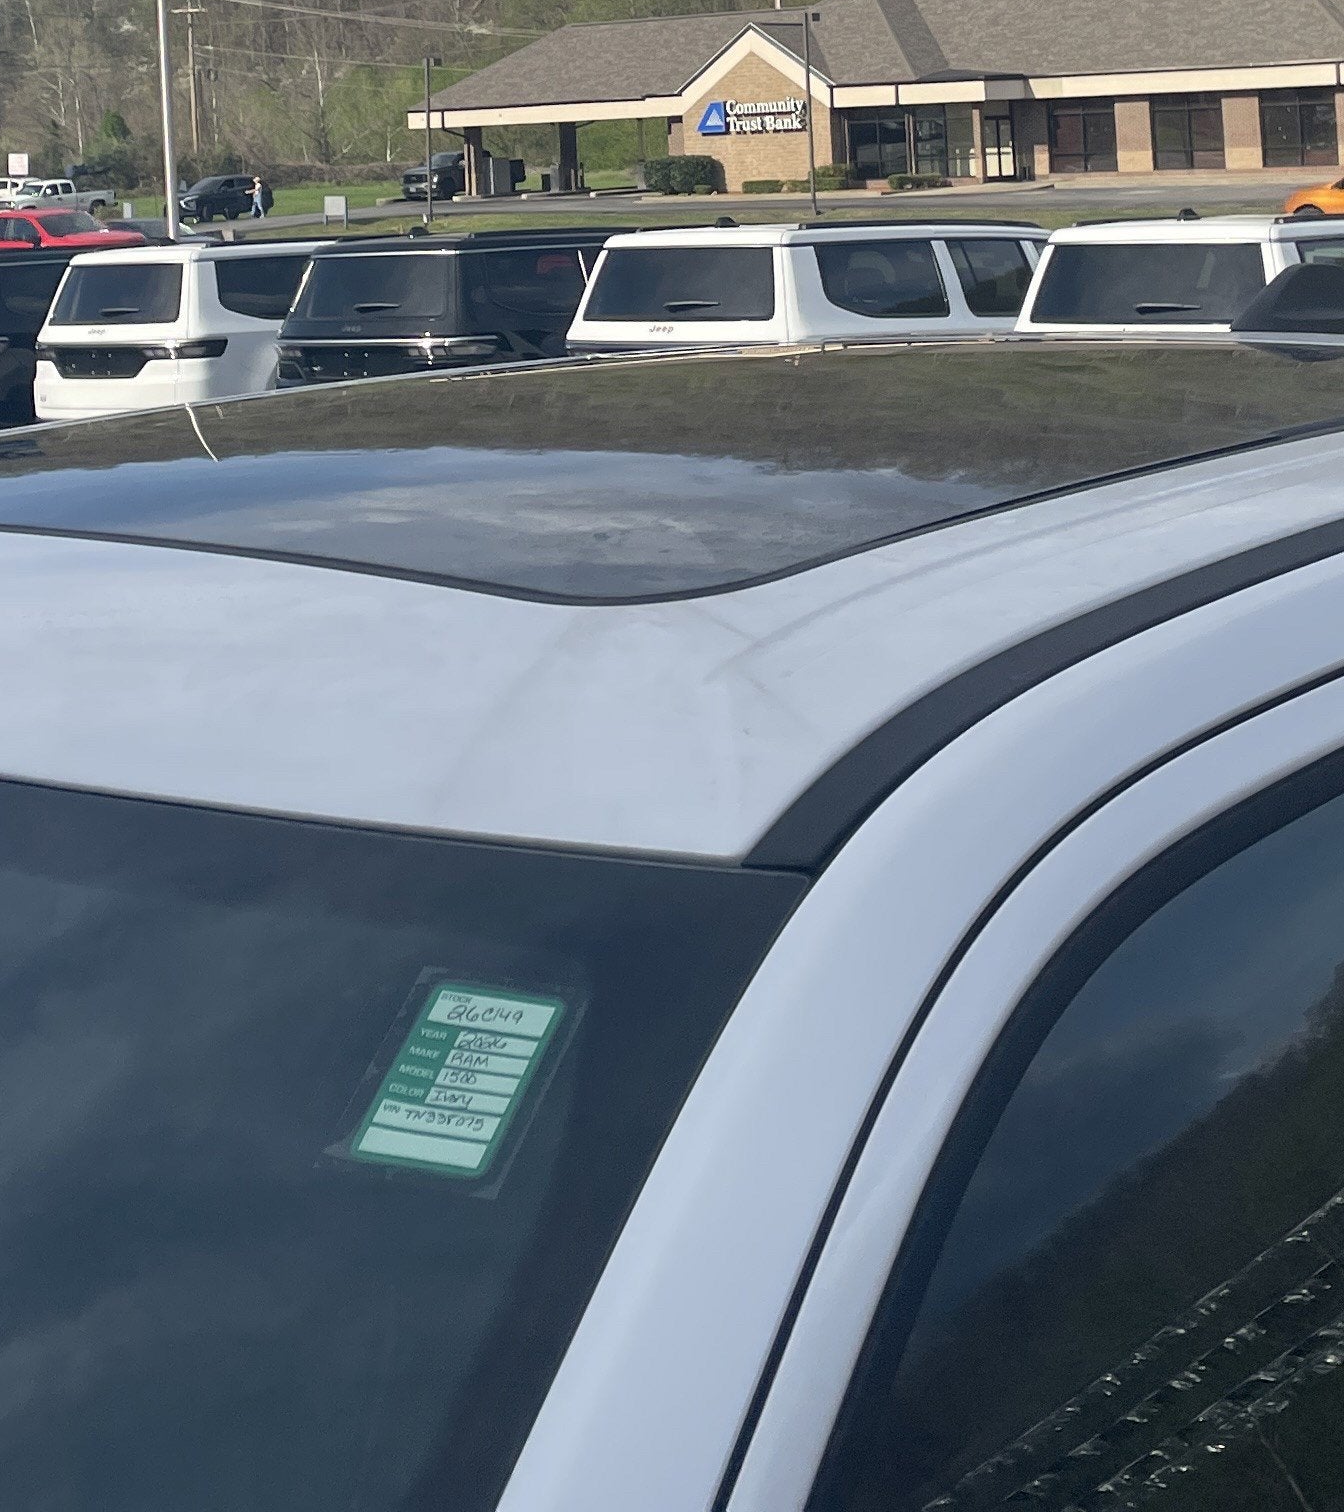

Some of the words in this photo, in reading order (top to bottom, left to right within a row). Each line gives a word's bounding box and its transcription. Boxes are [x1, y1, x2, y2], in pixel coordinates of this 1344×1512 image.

[725, 96, 804, 115] Community
[726, 116, 763, 132] Trust
[764, 113, 803, 130] Bank
[649, 325, 674, 334] Jeep
[421, 1027, 448, 1040] YEAR
[409, 1045, 441, 1059] MAKE
[449, 1052, 490, 1068] RAM
[398, 1064, 435, 1080] MODEL
[442, 1071, 478, 1086] 1500
[388, 1083, 425, 1099] COLOR
